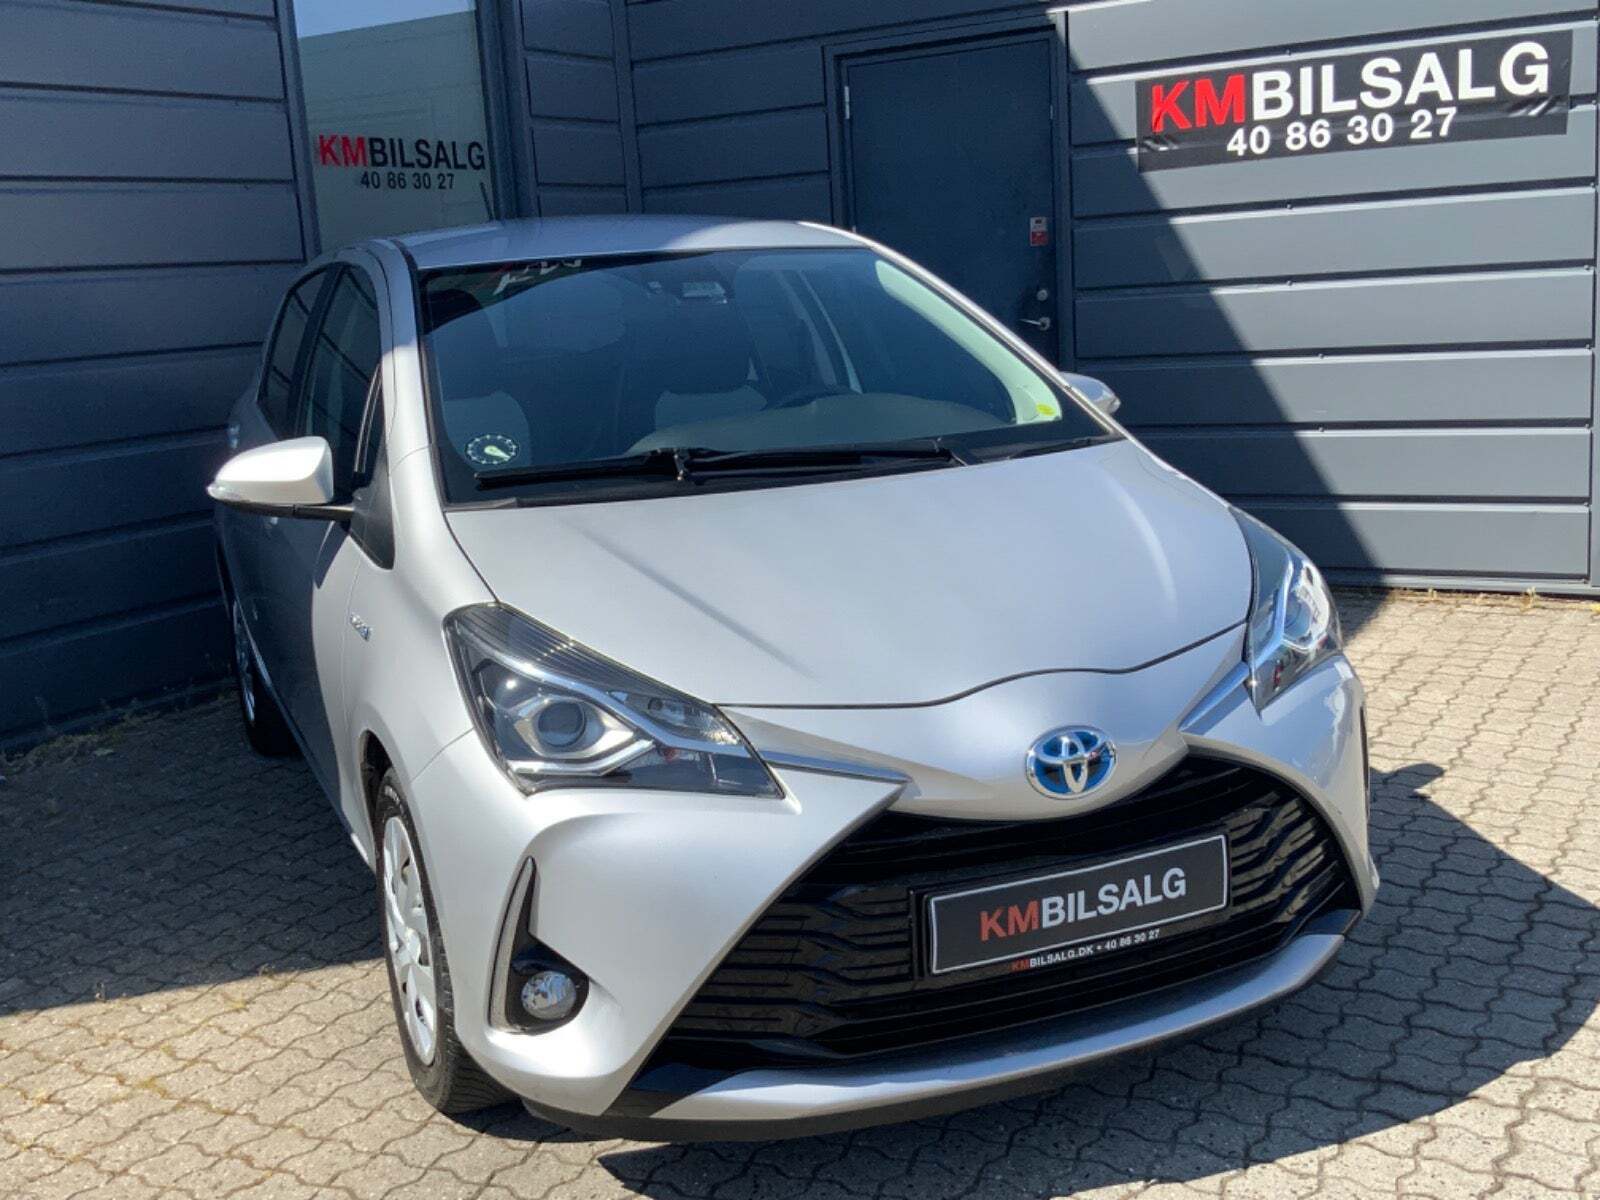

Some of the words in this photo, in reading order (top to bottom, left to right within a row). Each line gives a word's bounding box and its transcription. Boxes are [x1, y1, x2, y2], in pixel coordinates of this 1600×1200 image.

[1151, 41, 1550, 133] KMBILSALG
[318, 134, 486, 171] KMBILSALG
[1226, 126, 1271, 157] 40
[1285, 120, 1331, 151] 86
[1346, 113, 1394, 145] 30
[1409, 106, 1459, 140] 27
[361, 171, 381, 189] 40
[387, 171, 407, 189] 86
[413, 172, 431, 190] 30
[437, 173, 455, 190] 27
[979, 867, 1187, 942] KMBILSALG
[1010, 945, 1094, 972] KMBILSALG.DK
[1104, 939, 1117, 951] 40
[1148, 928, 1160, 940] 27
